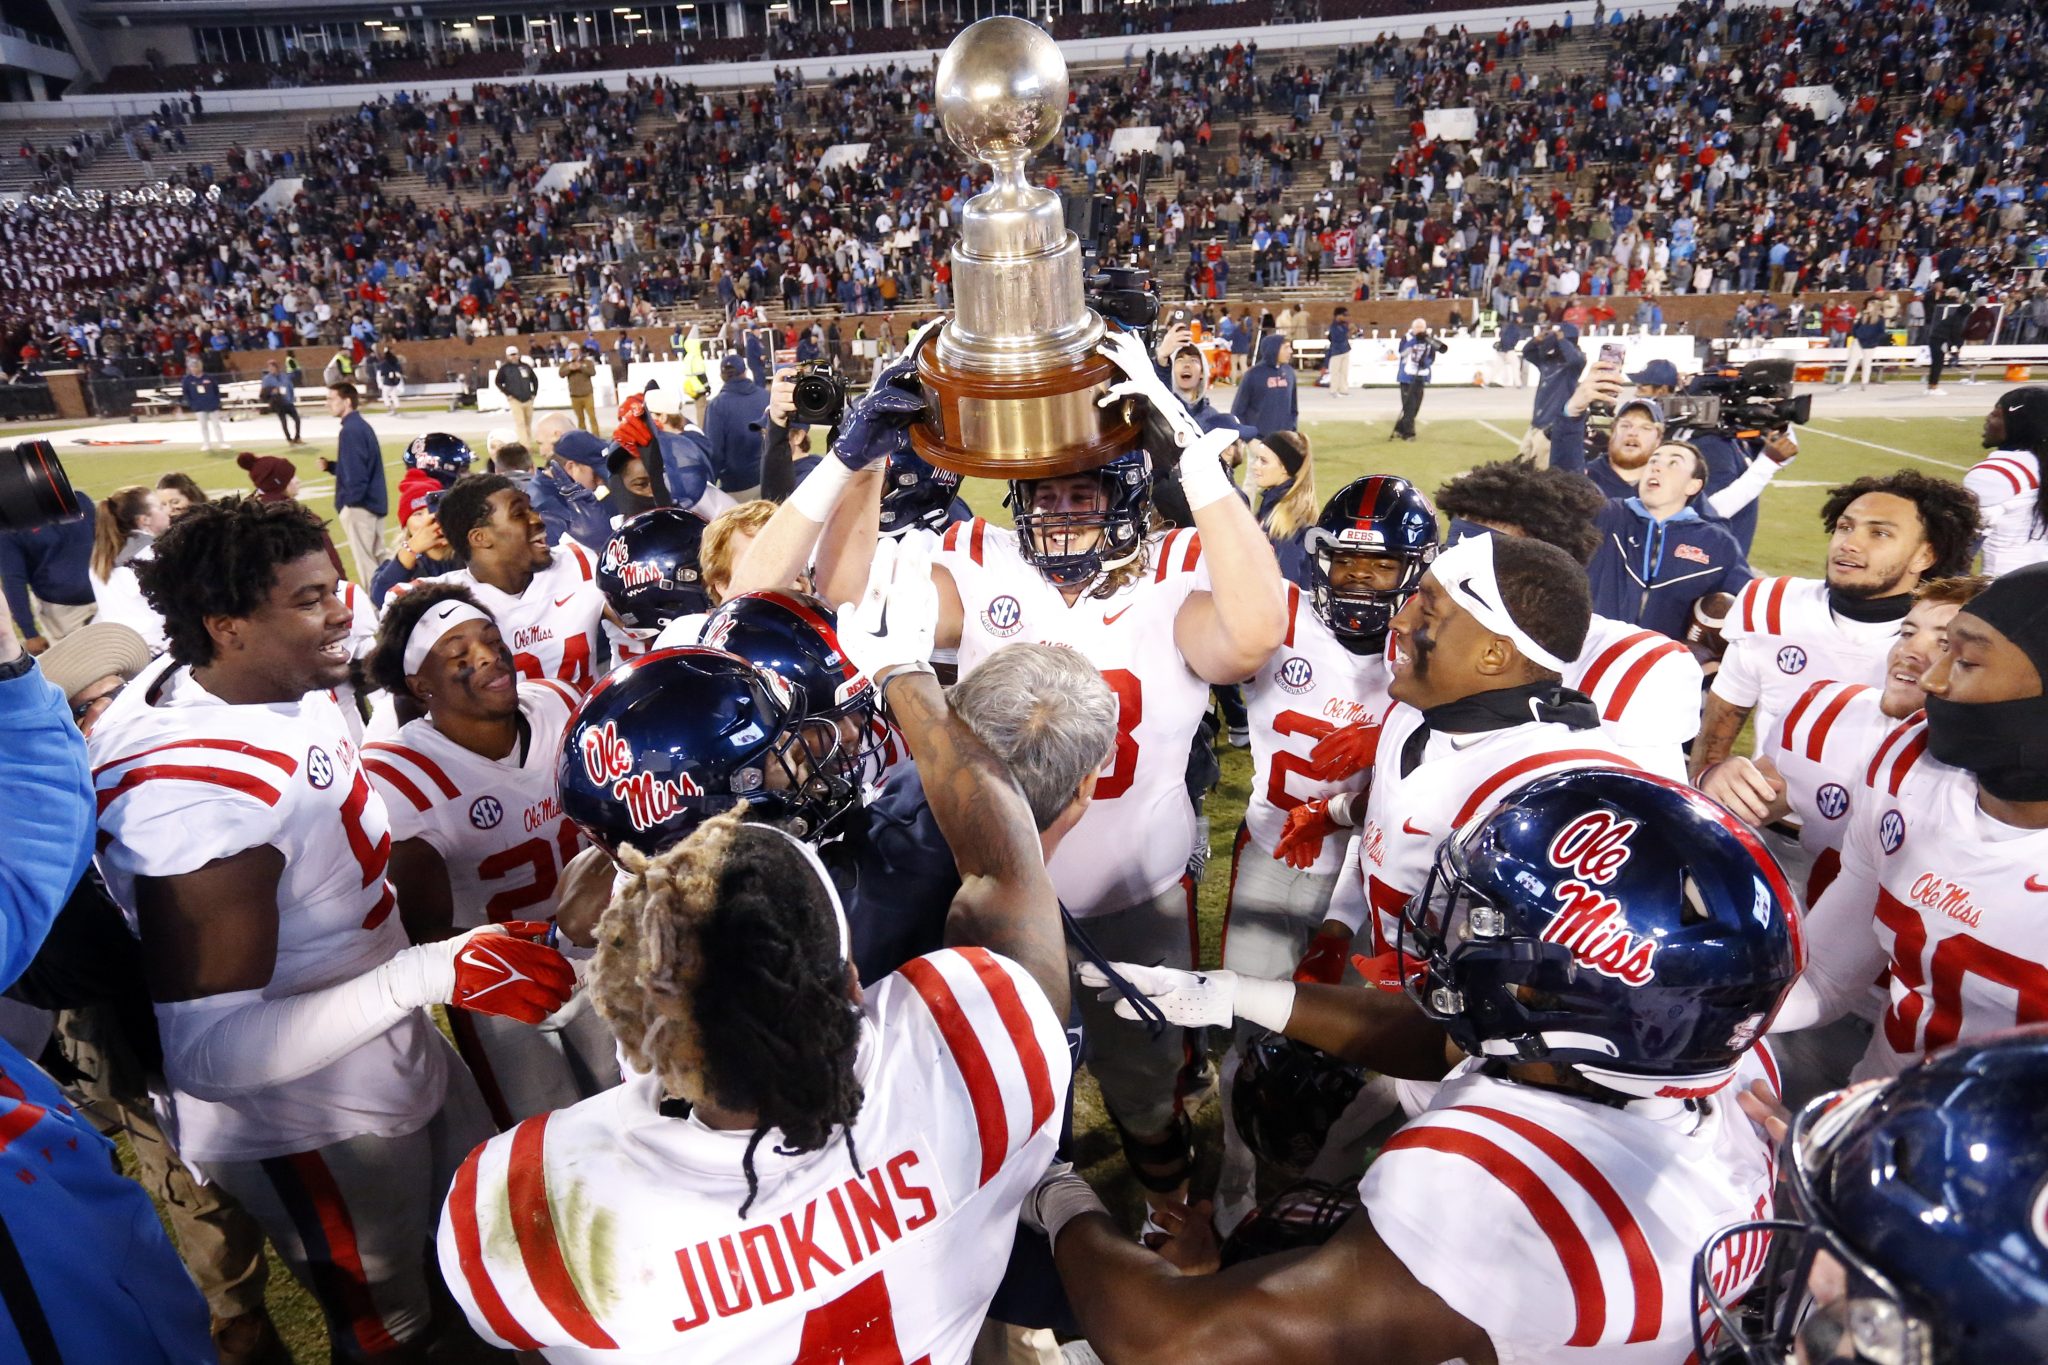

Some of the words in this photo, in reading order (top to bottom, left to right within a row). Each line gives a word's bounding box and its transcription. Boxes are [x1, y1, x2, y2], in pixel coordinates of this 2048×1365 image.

[1347, 530, 1374, 541] REBS
[990, 597, 1019, 627] SEC
[514, 629, 530, 649] Ole
[528, 625, 554, 644] Miss
[1283, 658, 1311, 687] SEC
[1778, 646, 1806, 673] SEC
[1322, 697, 1344, 718] Ole
[1342, 701, 1374, 723] Miss
[584, 718, 633, 787] Ole
[471, 798, 502, 829] SEC
[523, 807, 542, 833] Ole
[538, 796, 563, 822] Mis
[613, 770, 705, 833] Miss
[1818, 785, 1848, 817] SEC
[1548, 809, 1638, 885] Ole
[1879, 809, 1903, 856] SEC
[1909, 871, 1943, 908] Ole
[1936, 881, 1984, 930] Miss
[1540, 879, 1656, 987] Miss
[672, 1149, 938, 1333] JUDKINS
